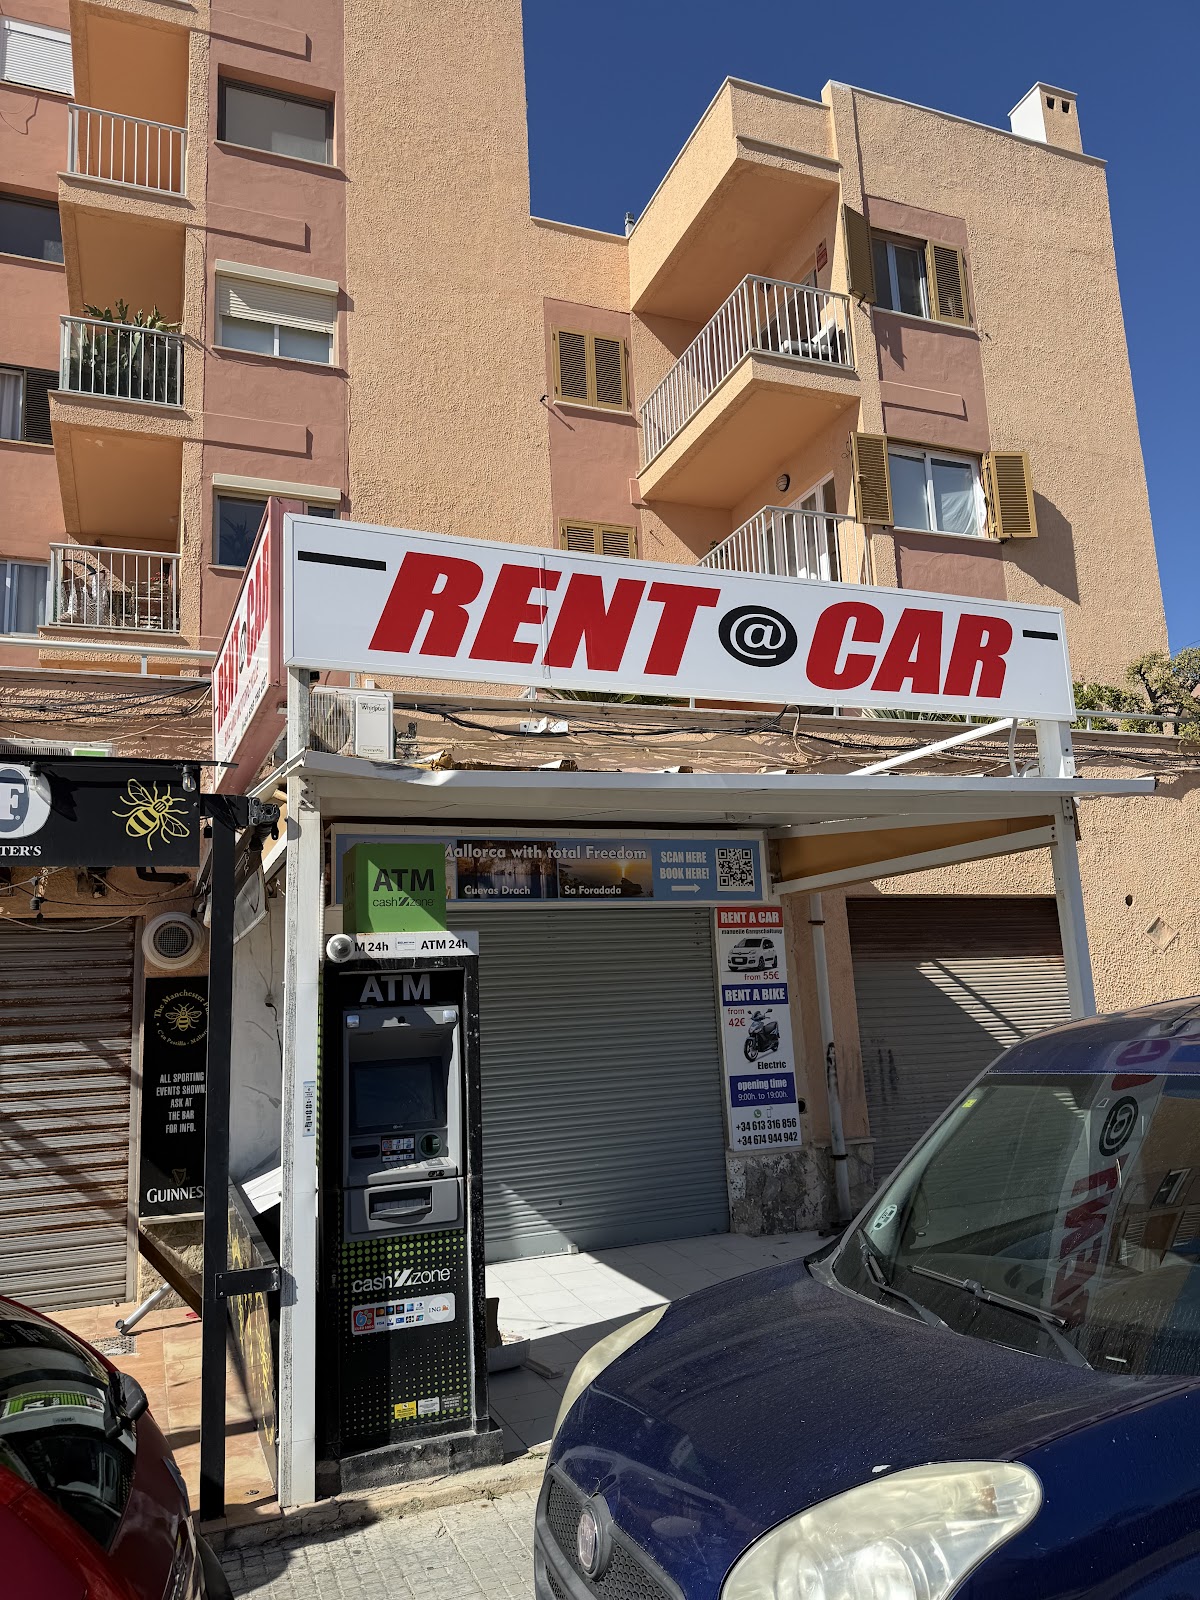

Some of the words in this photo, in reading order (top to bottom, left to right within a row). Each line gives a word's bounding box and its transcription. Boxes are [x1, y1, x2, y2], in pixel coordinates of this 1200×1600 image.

[368, 551, 721, 677] RENT
[727, 611, 789, 662] @
[806, 601, 1013, 698] CAR
[218, 615, 241, 734] RENT
[246, 530, 269, 668] CAR
[511, 845, 543, 859] with
[547, 846, 581, 859] total
[586, 846, 647, 860] Freedom
[660, 851, 685, 864] SCAN
[685, 851, 707, 863] HERE
[660, 867, 684, 880] BOOK
[685, 867, 710, 880] HERE!
[373, 869, 435, 892] ATM
[464, 885, 499, 895] Cuevas
[502, 885, 531, 895] Drach
[564, 885, 577, 895] Sa
[579, 885, 622, 895] Foradada
[720, 912, 747, 924] RENT
[749, 911, 757, 923] A
[758, 911, 780, 923] CAR
[368, 942, 389, 952] 24h
[421, 940, 446, 950] ATM
[448, 939, 468, 949] 24h
[763, 972, 780, 980] 55€
[359, 973, 431, 1003] ATM
[725, 989, 751, 1002] RENT
[753, 988, 761, 1001] A
[762, 988, 786, 1000] BIKE
[154, 1004, 165, 1019] The
[162, 989, 205, 1005] Manchester
[728, 1018, 746, 1027] 42€
[757, 1061, 787, 1070] Electric
[160, 1074, 172, 1084] ALL
[173, 1072, 205, 1083] SPORTING
[156, 1085, 181, 1097] EVENTS
[737, 1079, 769, 1091] opening
[770, 1079, 788, 1088] time
[738, 1093, 758, 1101] 9:00h.
[767, 1091, 789, 1099] 19:00h.
[170, 1098, 184, 1108] ASK
[184, 1097, 193, 1107] AT
[168, 1111, 181, 1121] THE
[181, 1110, 195, 1120] BAR
[165, 1124, 178, 1134] FOR
[179, 1122, 197, 1133] INFO.
[736, 1121, 751, 1132] +34
[752, 1120, 766, 1131] 613
[767, 1119, 781, 1130] 316
[782, 1118, 797, 1128] 856
[737, 1135, 752, 1146] +34
[753, 1134, 767, 1145] 674
[768, 1133, 782, 1144] 944
[783, 1132, 798, 1142] 942
[146, 1186, 205, 1204] GUINNES
